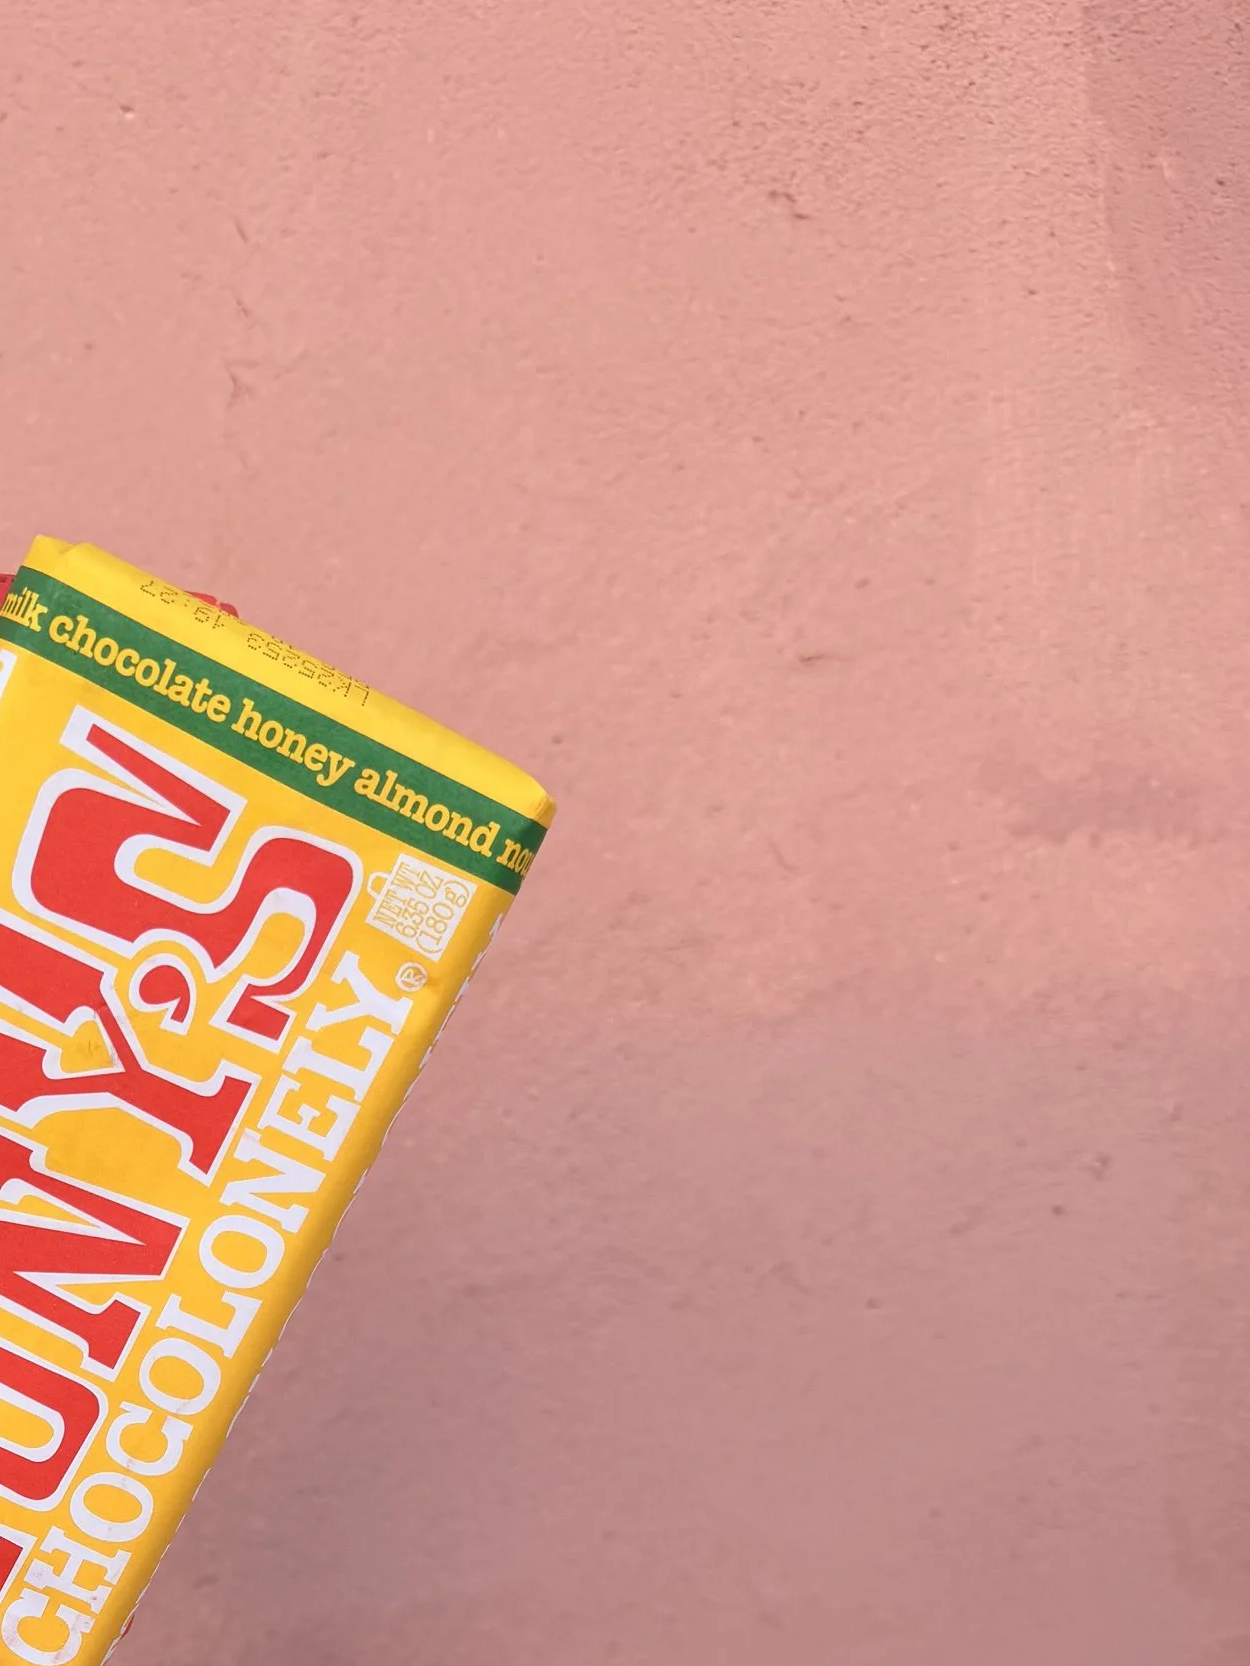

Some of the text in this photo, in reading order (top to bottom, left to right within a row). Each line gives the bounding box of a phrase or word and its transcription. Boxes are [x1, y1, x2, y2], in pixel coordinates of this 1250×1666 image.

[0, 587, 48, 632] milk
[49, 614, 231, 723] chocolate
[231, 697, 355, 787] honey
[355, 768, 500, 857] almond
[496, 839, 535, 880] nou
[373, 861, 421, 928] NET WT
[415, 869, 445, 899] OZ
